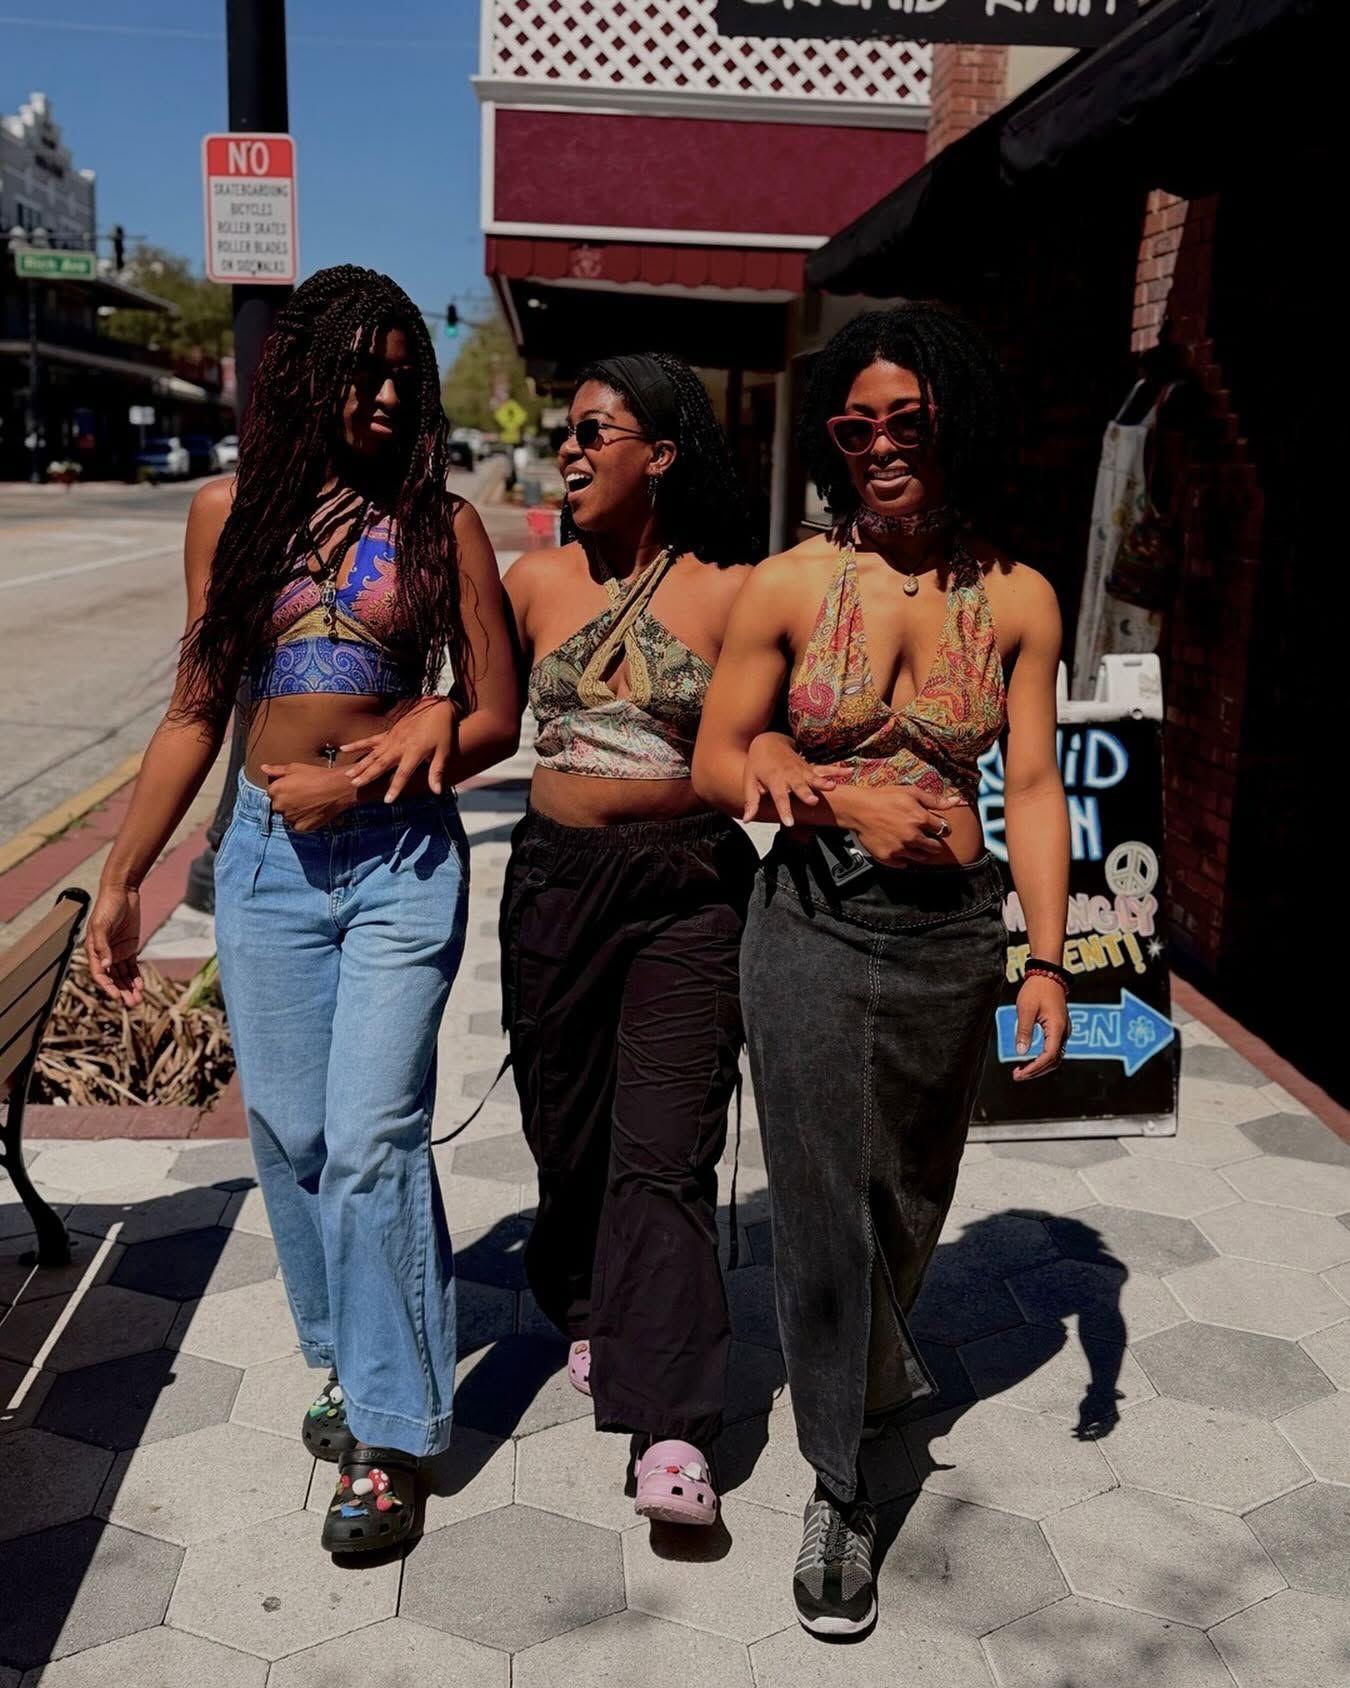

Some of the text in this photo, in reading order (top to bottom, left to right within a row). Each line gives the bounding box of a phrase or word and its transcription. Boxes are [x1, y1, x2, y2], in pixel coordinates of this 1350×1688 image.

[227, 141, 270, 175] NO
[214, 183, 288, 197] SKATEBOARDING
[231, 203, 272, 216] BICYCLES
[217, 221, 287, 235] ROLLER SKATES
[217, 240, 288, 254] ROLLER BLADES
[221, 258, 285, 273] ON SIDEWALKS
